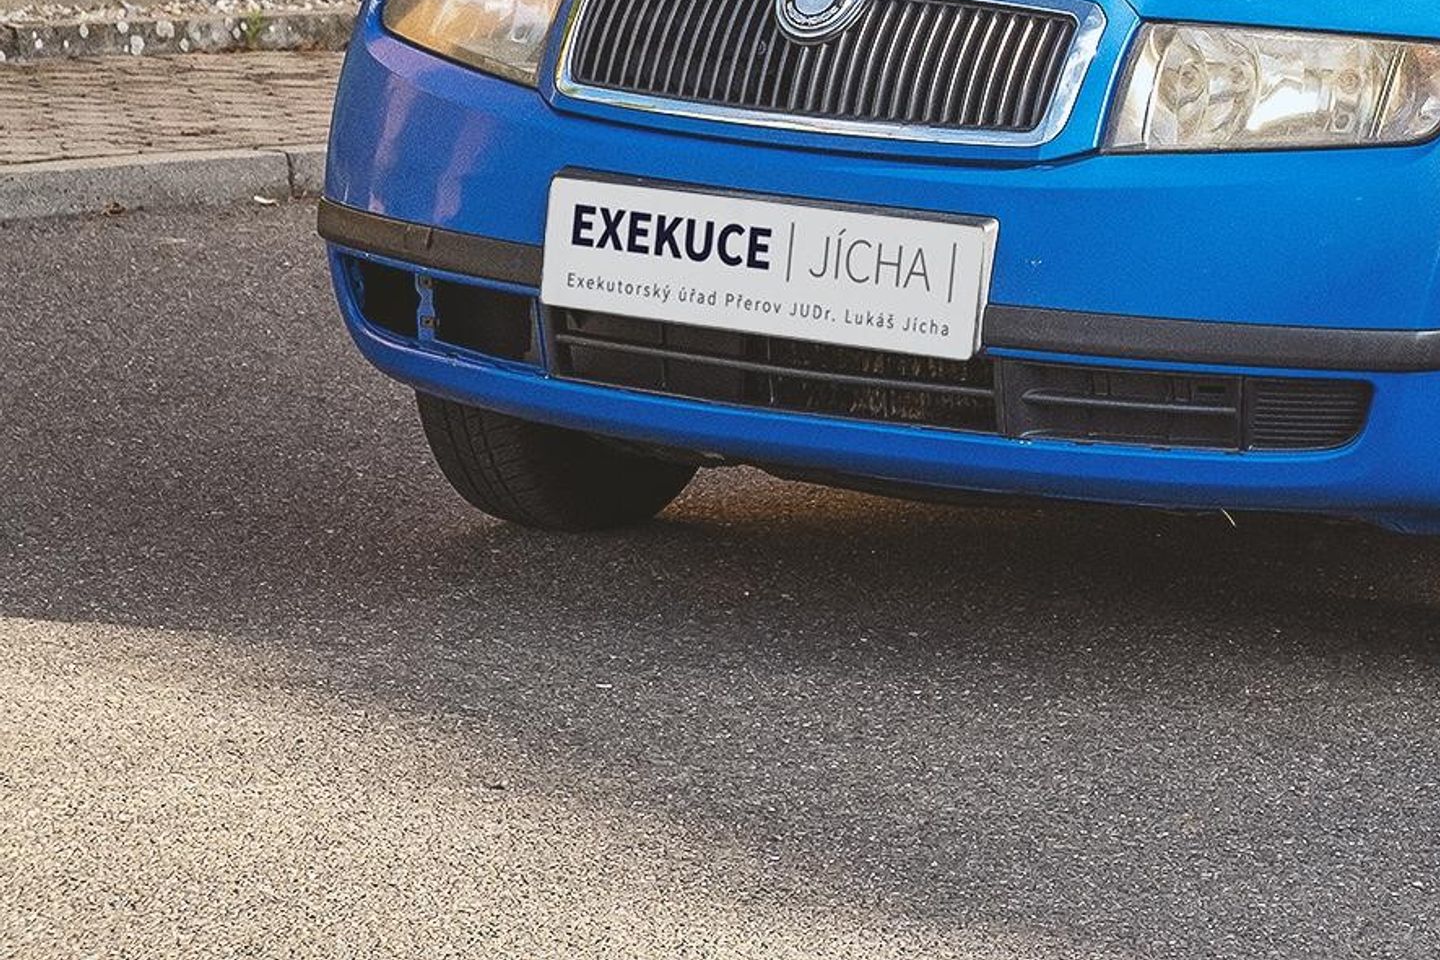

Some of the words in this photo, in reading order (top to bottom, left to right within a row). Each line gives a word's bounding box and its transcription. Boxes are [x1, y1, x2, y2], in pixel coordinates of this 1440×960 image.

[571, 203, 773, 270] EXEKUCE
[808, 228, 931, 292] JÍCHA
[566, 272, 672, 303] Exekutorský
[678, 288, 717, 307] úřad
[724, 292, 783, 315] Přerov
[789, 301, 836, 323] JUDr.
[844, 309, 895, 330] Lukáš
[902, 317, 950, 337] Jícha
